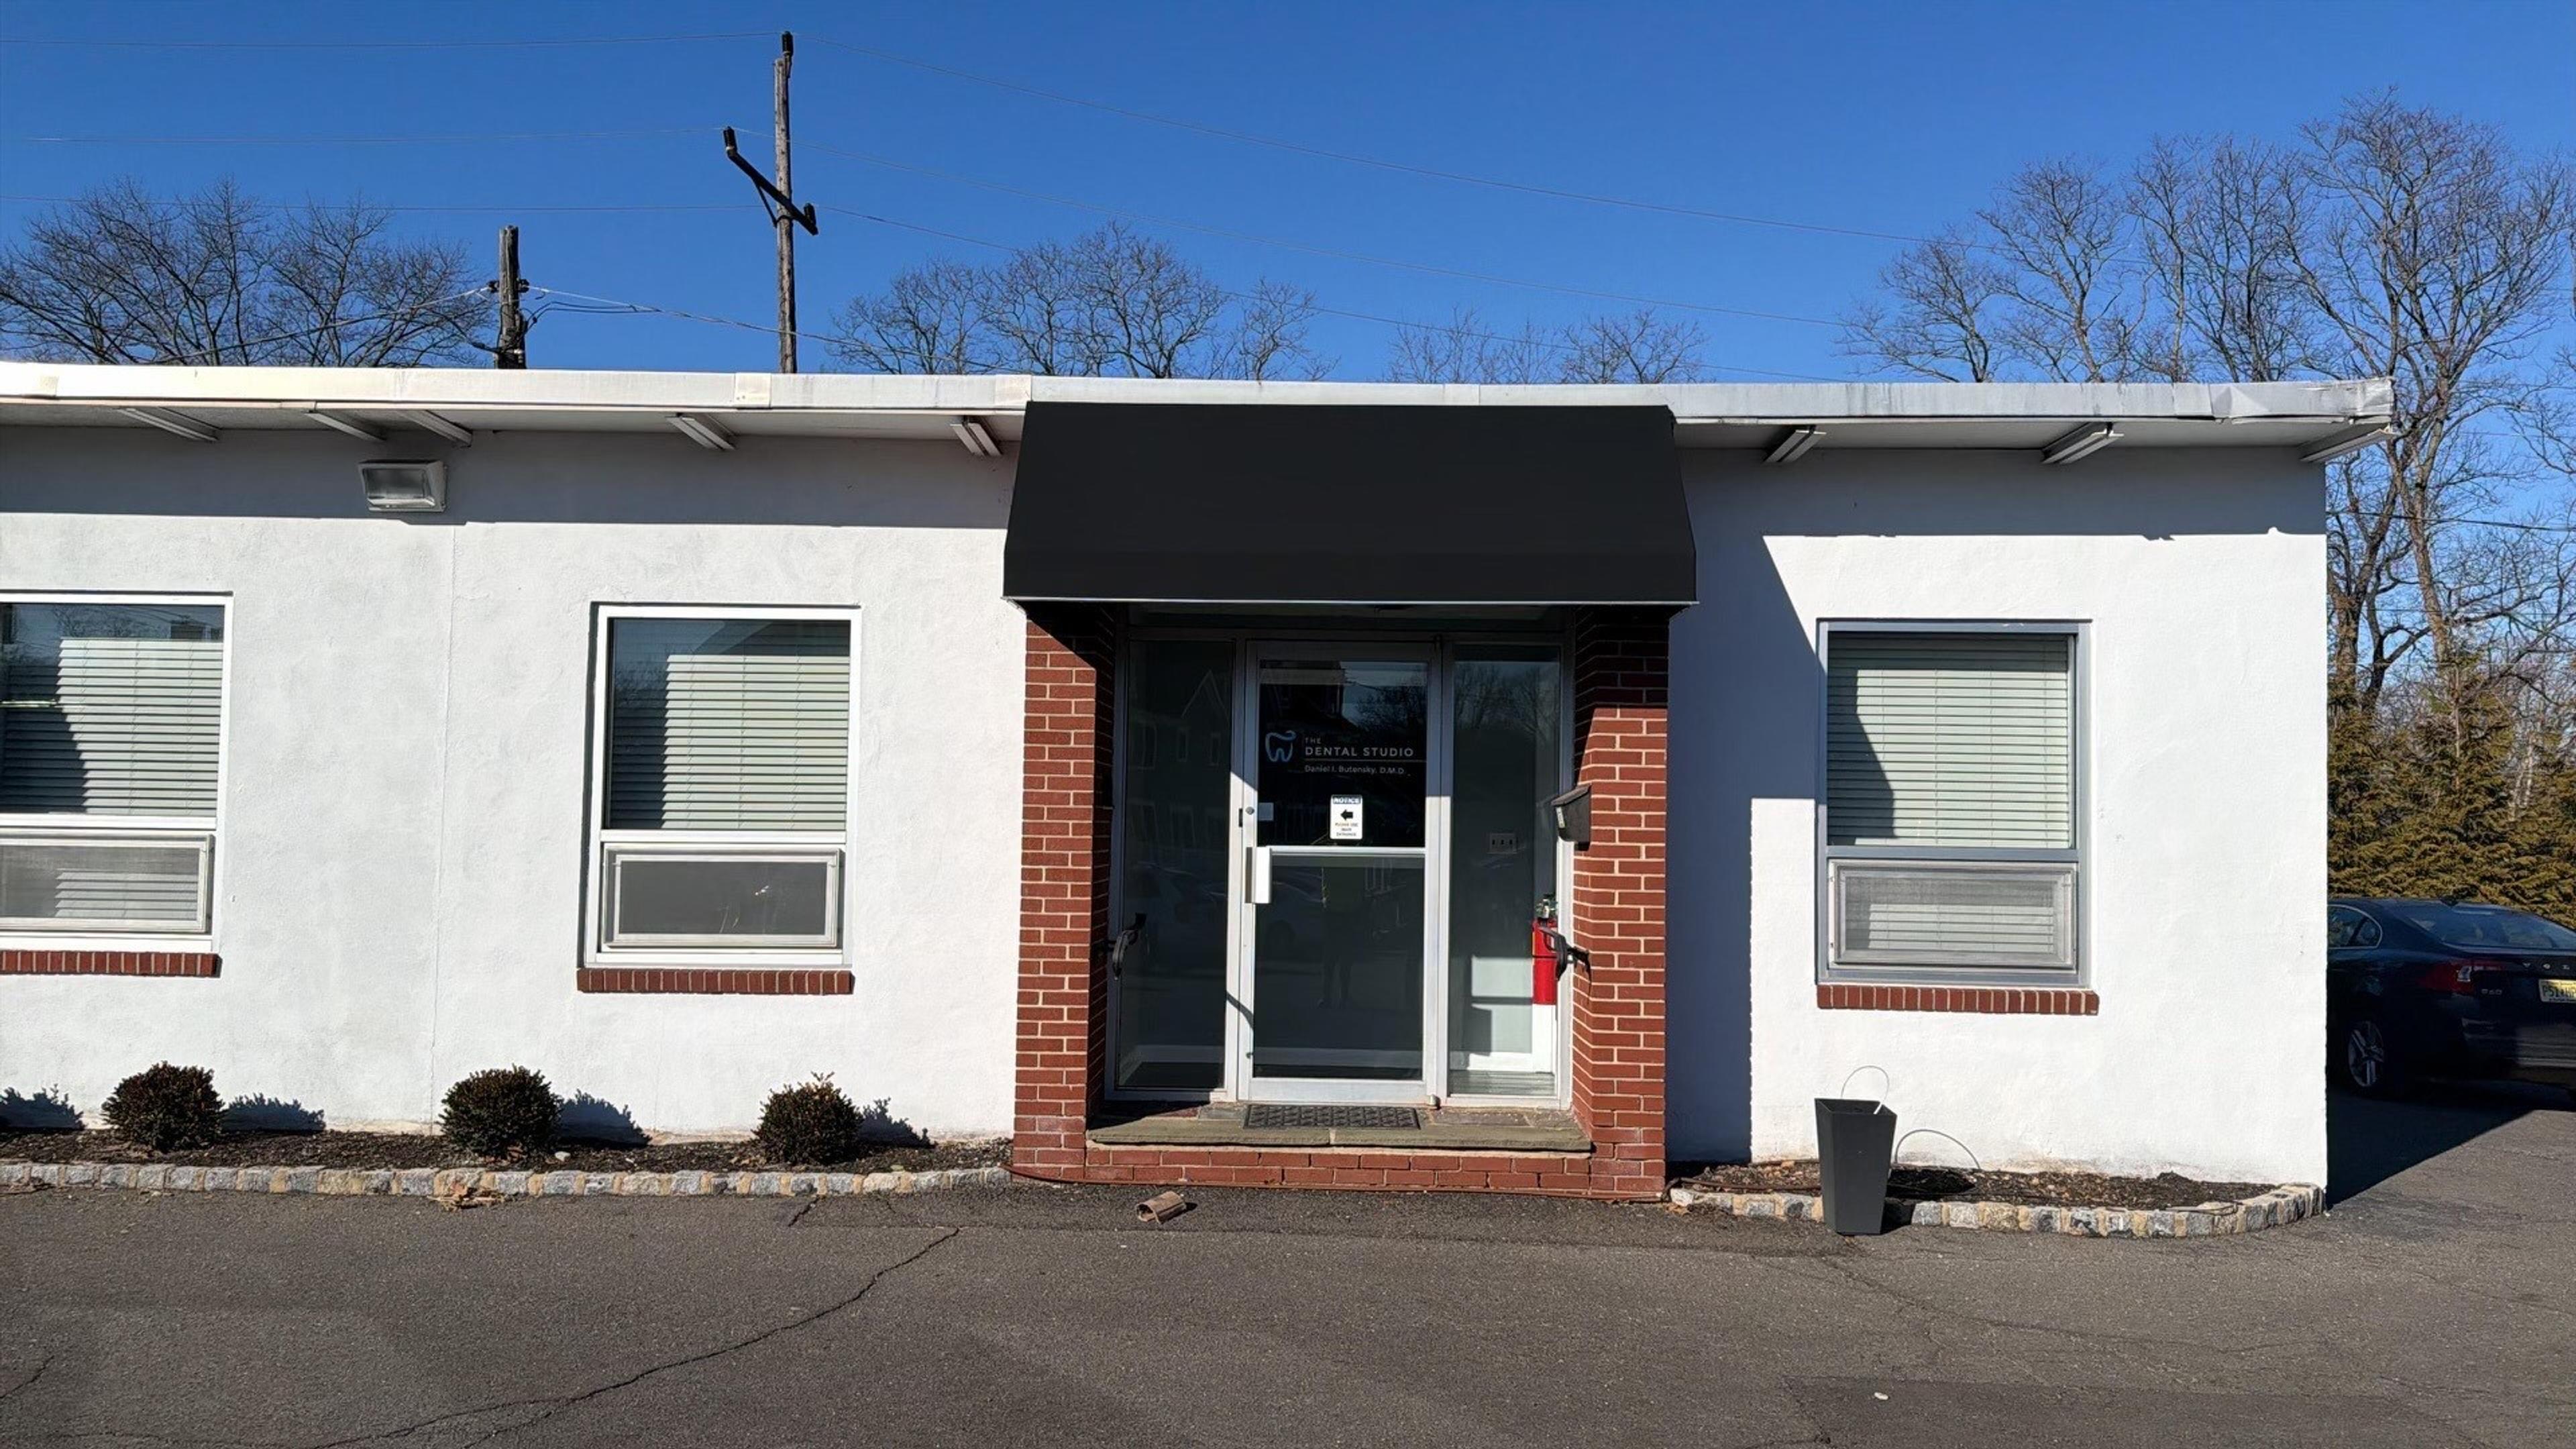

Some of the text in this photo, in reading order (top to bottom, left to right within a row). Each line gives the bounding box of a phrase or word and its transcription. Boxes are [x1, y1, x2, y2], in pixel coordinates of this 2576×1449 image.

[1305, 747, 1413, 757] DENTAL STUDIO
[1305, 765, 1330, 773] Daniel
